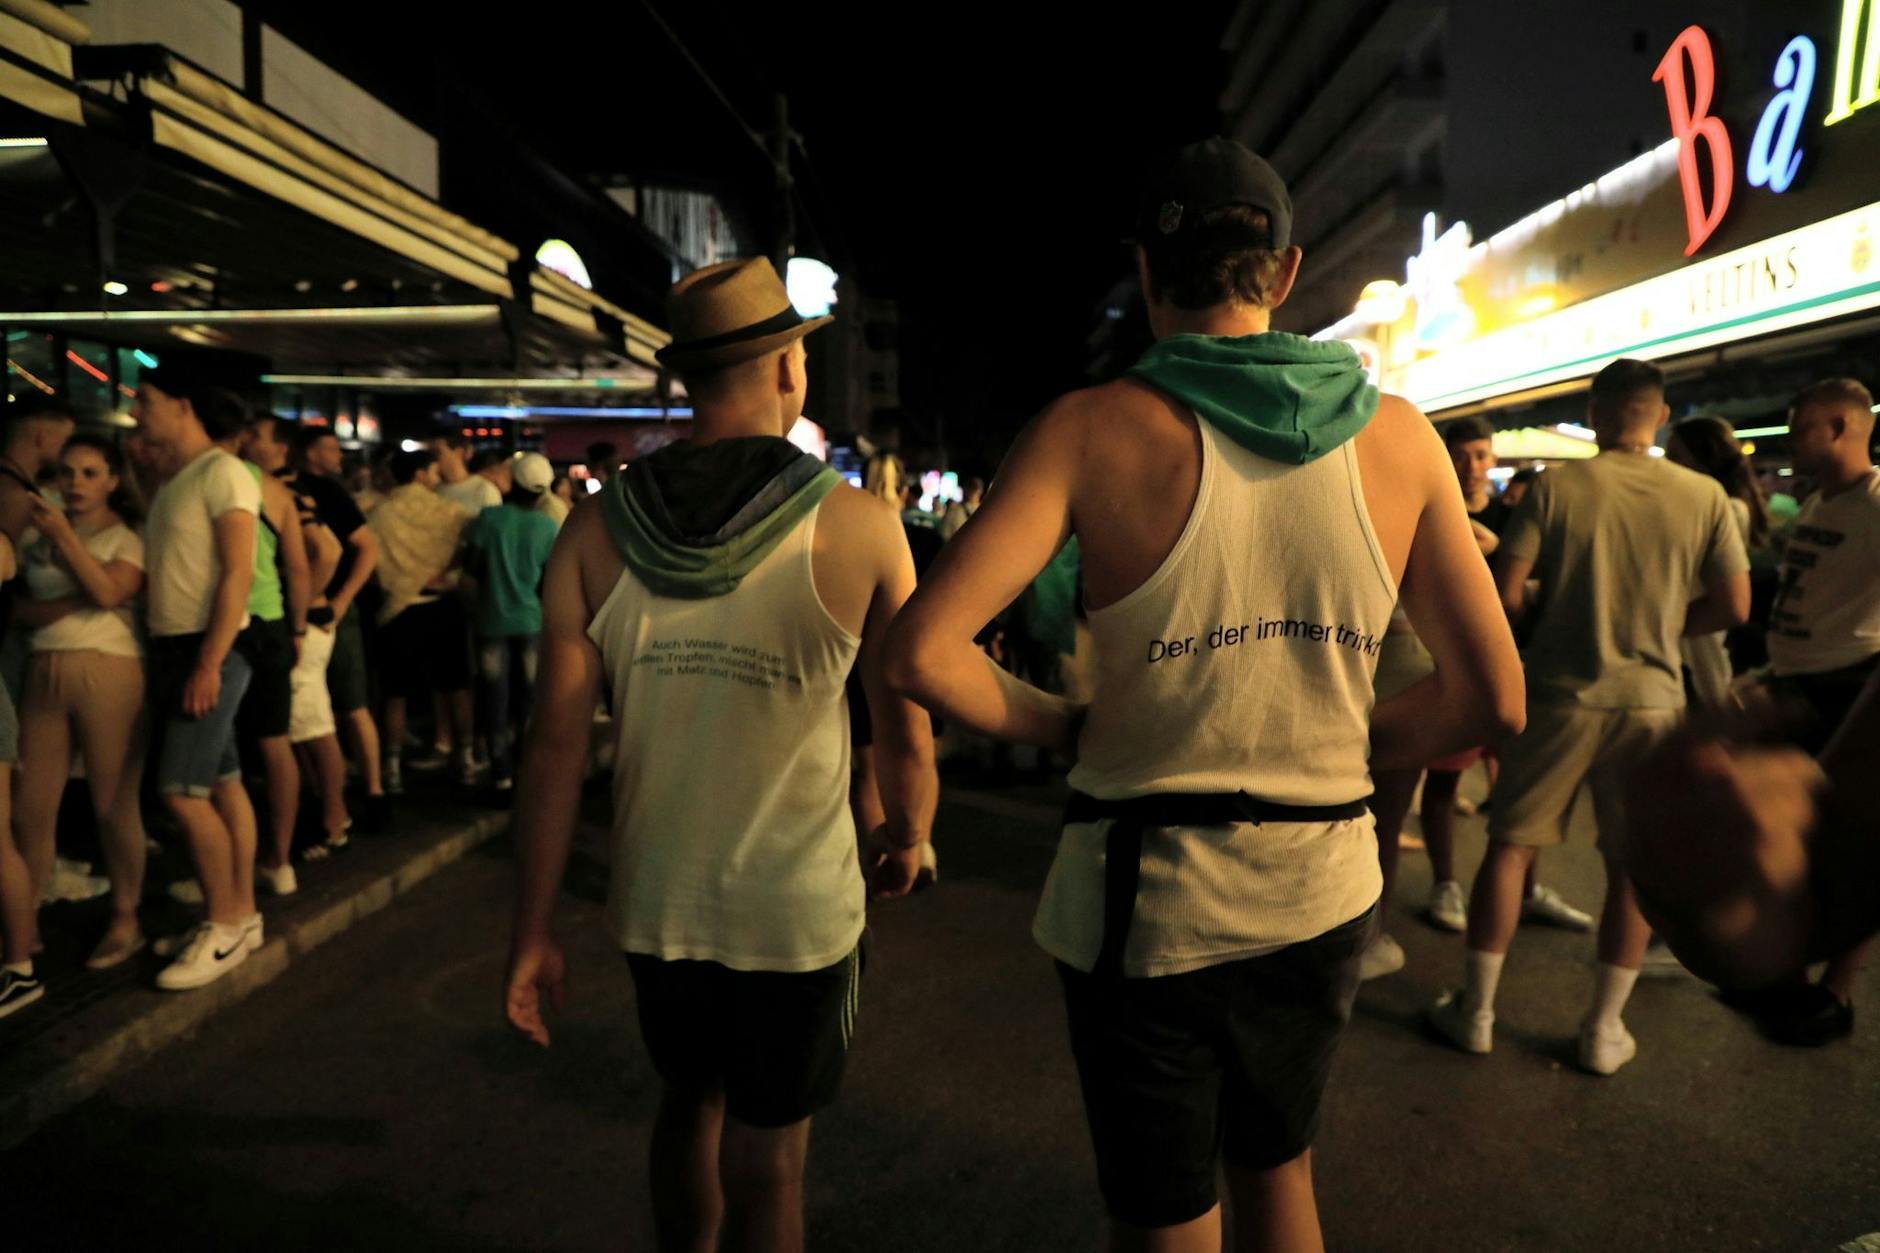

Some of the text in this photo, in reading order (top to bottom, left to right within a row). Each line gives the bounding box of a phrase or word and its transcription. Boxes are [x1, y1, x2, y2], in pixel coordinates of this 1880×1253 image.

[652, 639, 681, 649] Auch
[684, 639, 727, 651] Wasser
[731, 645, 756, 657] wird
[1148, 636, 1198, 663] Der,
[1208, 624, 1249, 649] der
[1257, 617, 1332, 643] immer
[657, 667, 673, 676] mit
[677, 665, 706, 676] Malz
[710, 668, 727, 680] und
